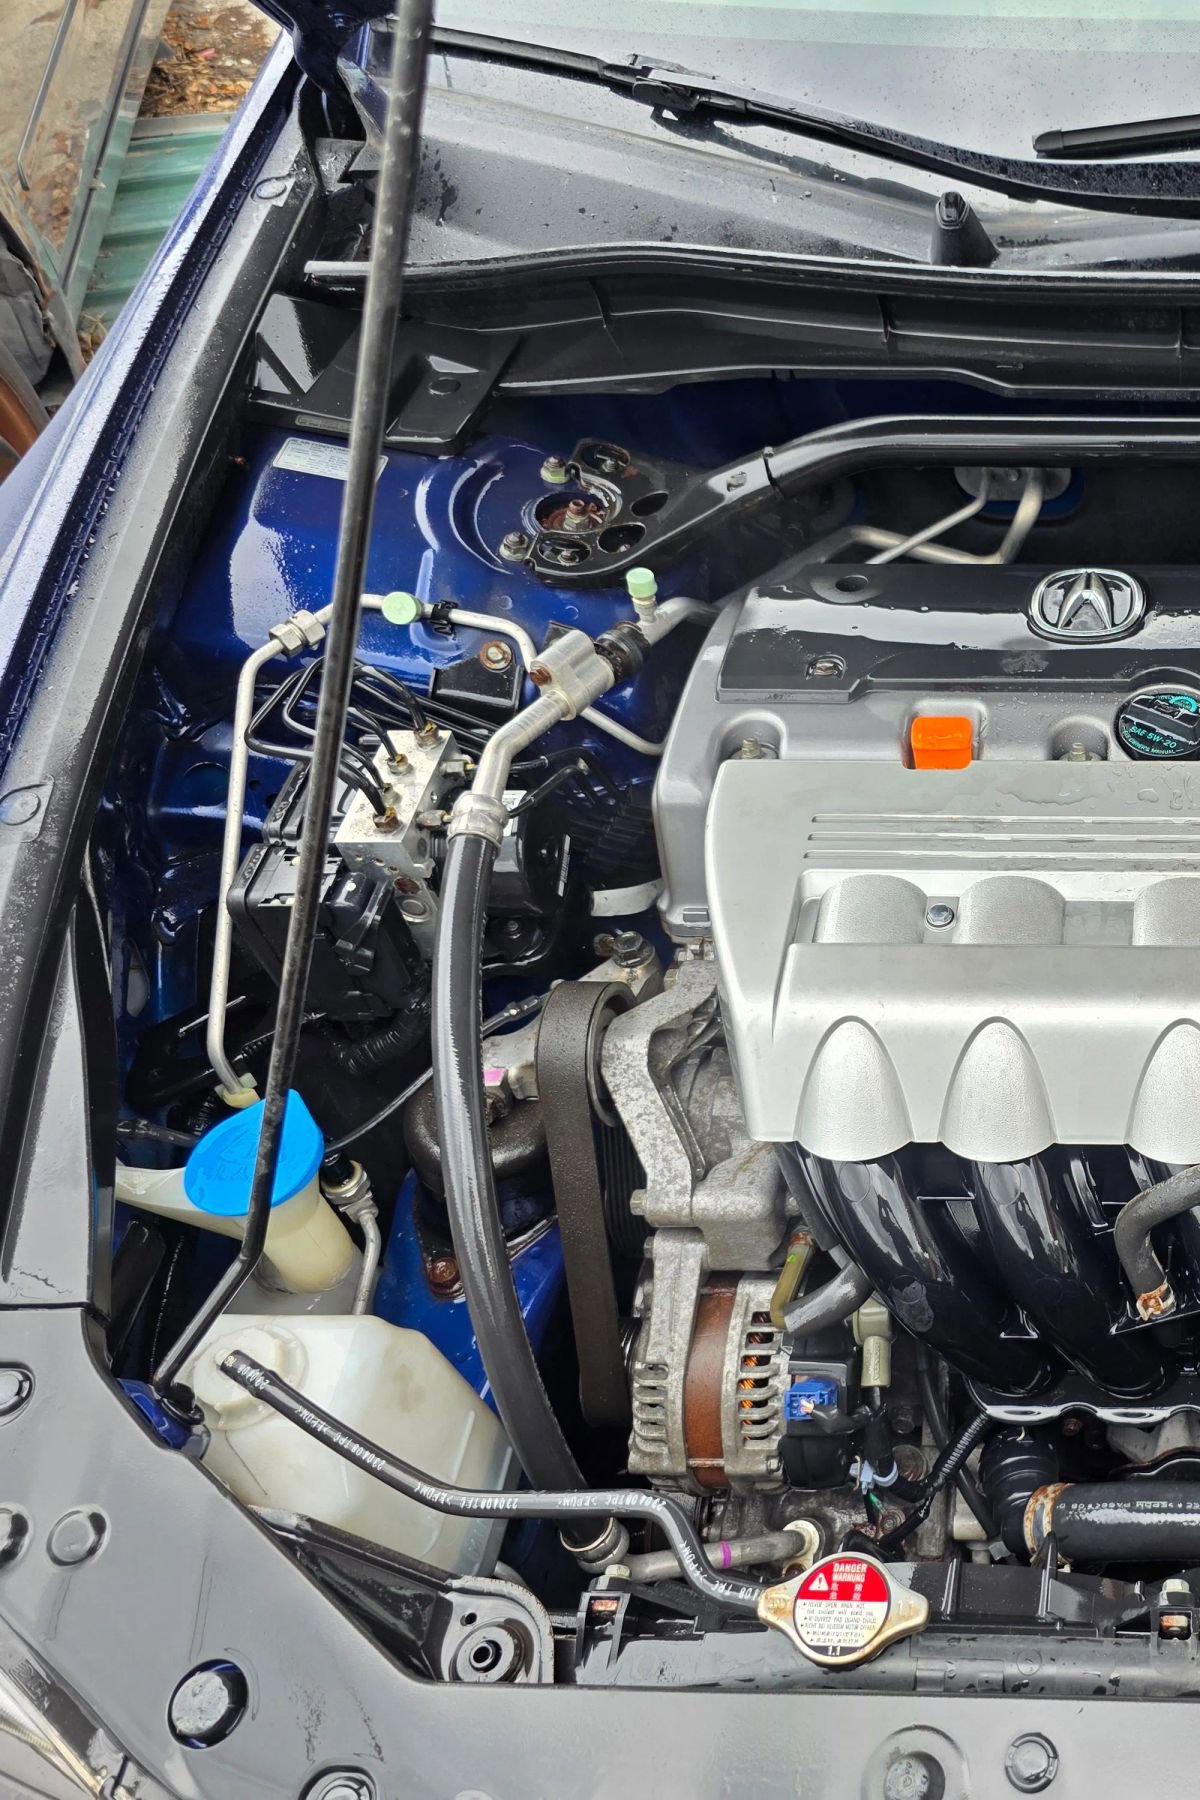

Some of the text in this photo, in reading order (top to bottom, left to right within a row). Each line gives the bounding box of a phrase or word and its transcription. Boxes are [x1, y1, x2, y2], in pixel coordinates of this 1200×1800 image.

[1130, 725, 1177, 748] SAE 5W-20
[833, 1562, 868, 1573] DANGER
[832, 1572, 866, 1582] WARNUNG
[828, 1646, 841, 1656] 1.1
